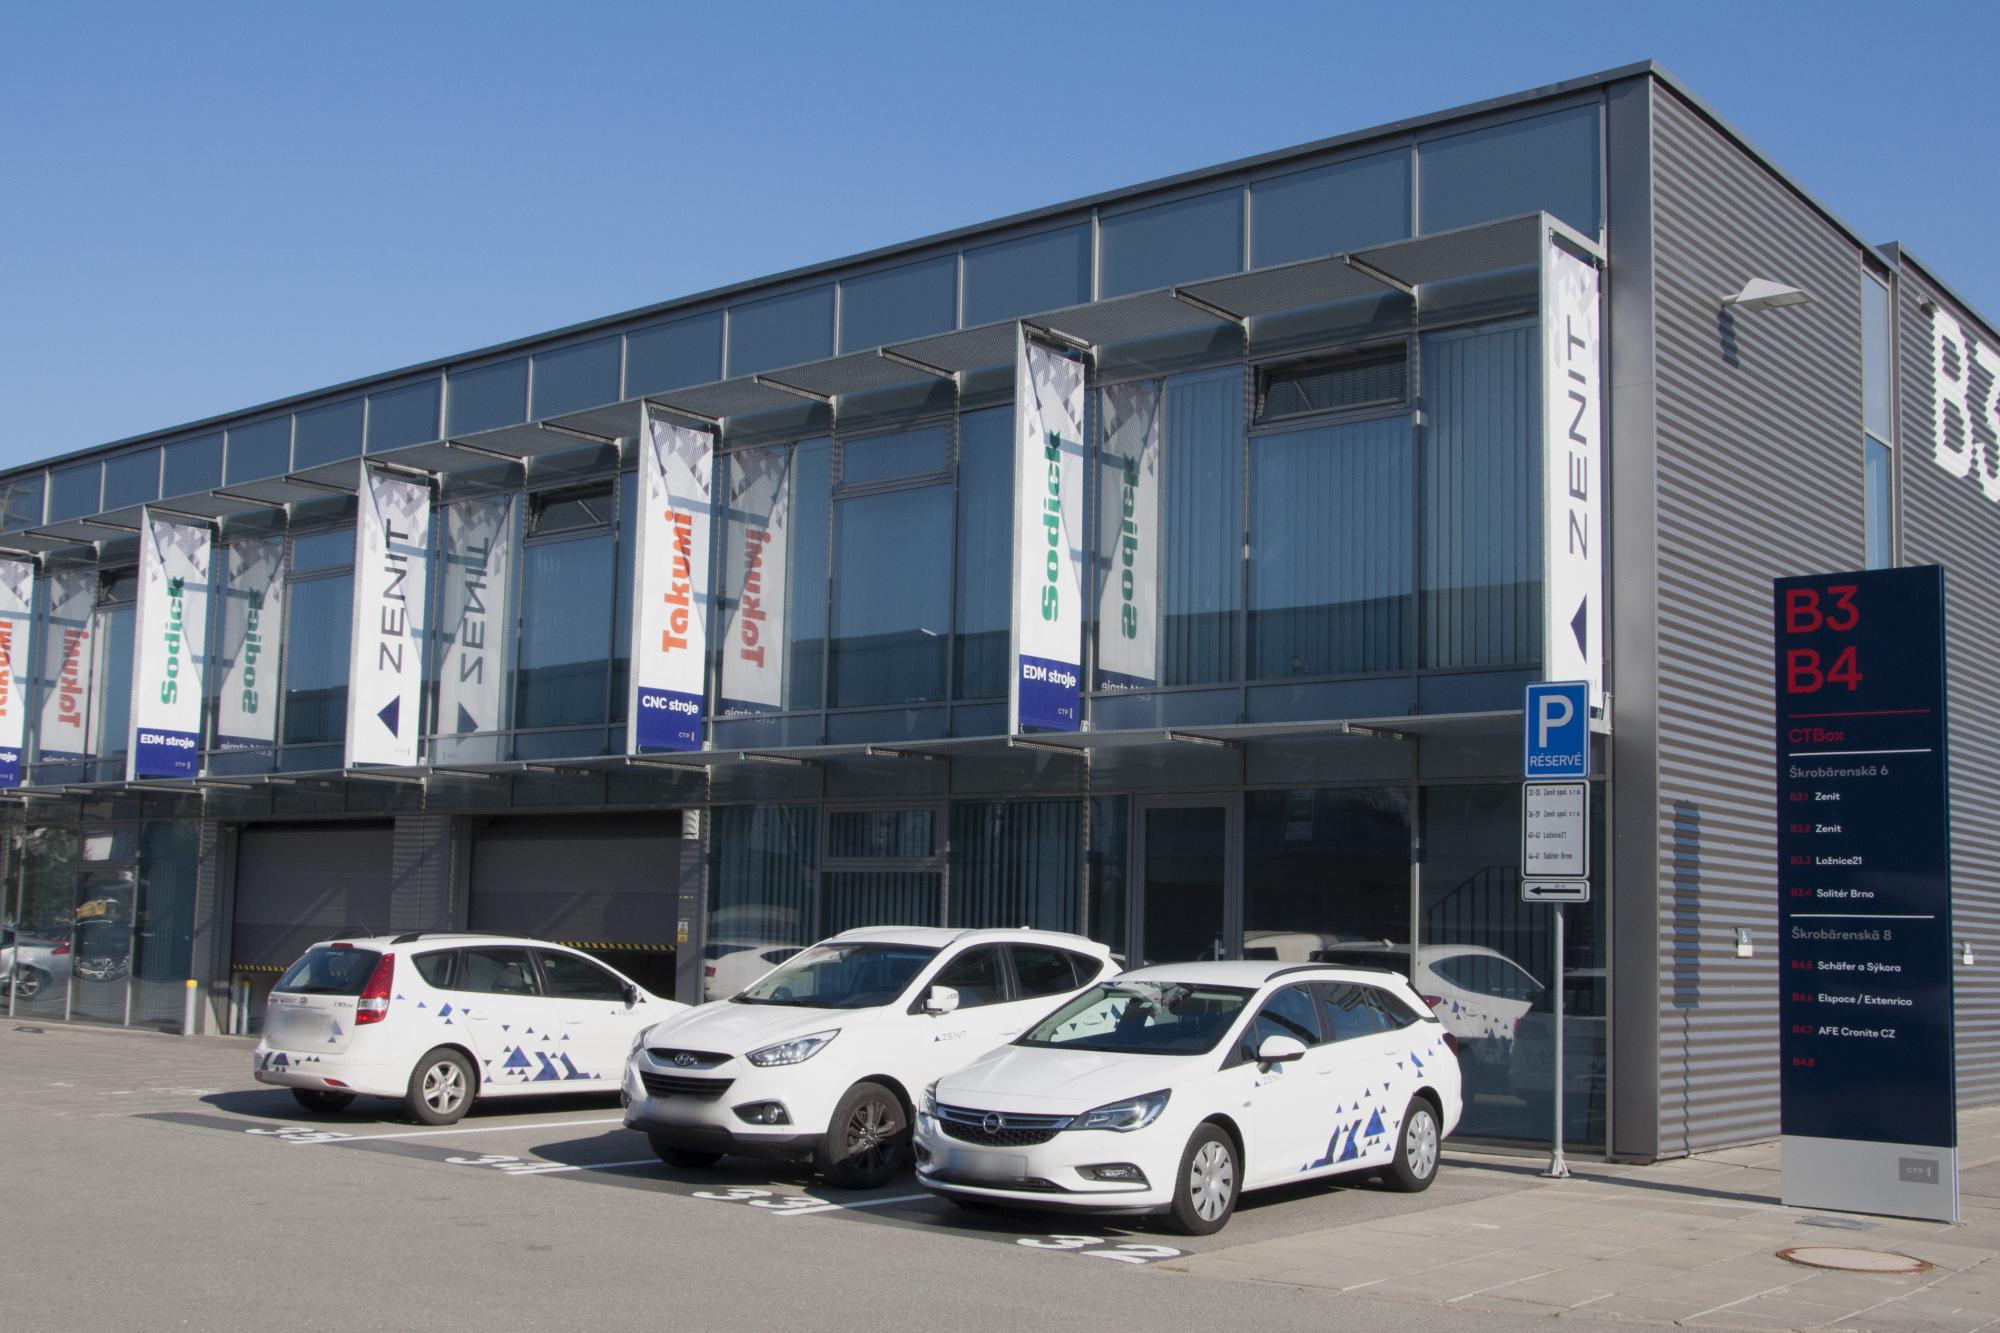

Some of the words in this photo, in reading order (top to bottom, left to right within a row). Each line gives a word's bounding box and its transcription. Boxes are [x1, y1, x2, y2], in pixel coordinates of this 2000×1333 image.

[1567, 314, 1588, 560] ZENIT
[1041, 428, 1061, 623] Sodick
[662, 509, 693, 653] Takumi
[379, 518, 408, 674] ZENIT
[1786, 585, 1859, 633] B3
[160, 576, 184, 705] Sodick
[1023, 664, 1047, 683] EDM
[1048, 667, 1076, 688] stroje
[1787, 645, 1863, 694] B4
[642, 695, 667, 711] CNC
[668, 698, 698, 715] stroje
[1538, 694, 1574, 748] P
[141, 734, 164, 745] EDM
[165, 736, 195, 749] stroje
[1788, 728, 1845, 743] CTBox
[1530, 752, 1582, 767] RÉSERVÉ
[1880, 765, 1889, 776] 6
[1815, 792, 1840, 801] Zenit
[1815, 824, 1842, 833] Zenit
[1816, 856, 1862, 865] Ložnice21
[1791, 888, 1812, 897] B3.4
[1816, 888, 1848, 898] Solitér
[1850, 889, 1874, 898] Brno
[1883, 929, 1893, 941] 8
[1791, 960, 1813, 970] B4.5
[1817, 961, 1856, 970] Schäfer
[1866, 962, 1901, 974] Sýkora
[1792, 993, 1814, 1002] B4.6
[1818, 993, 1856, 1005] Elspace
[1864, 995, 1913, 1006] Extenrico
[1792, 1025, 1813, 1035] B4.7
[1818, 1026, 1839, 1036] AFE
[1841, 1027, 1879, 1037] Cronite
[1880, 1029, 1896, 1039] CZ
[1793, 1057, 1816, 1067] B4.8
[692, 1188, 830, 1209] 33
[1016, 1234, 1181, 1264] 32
